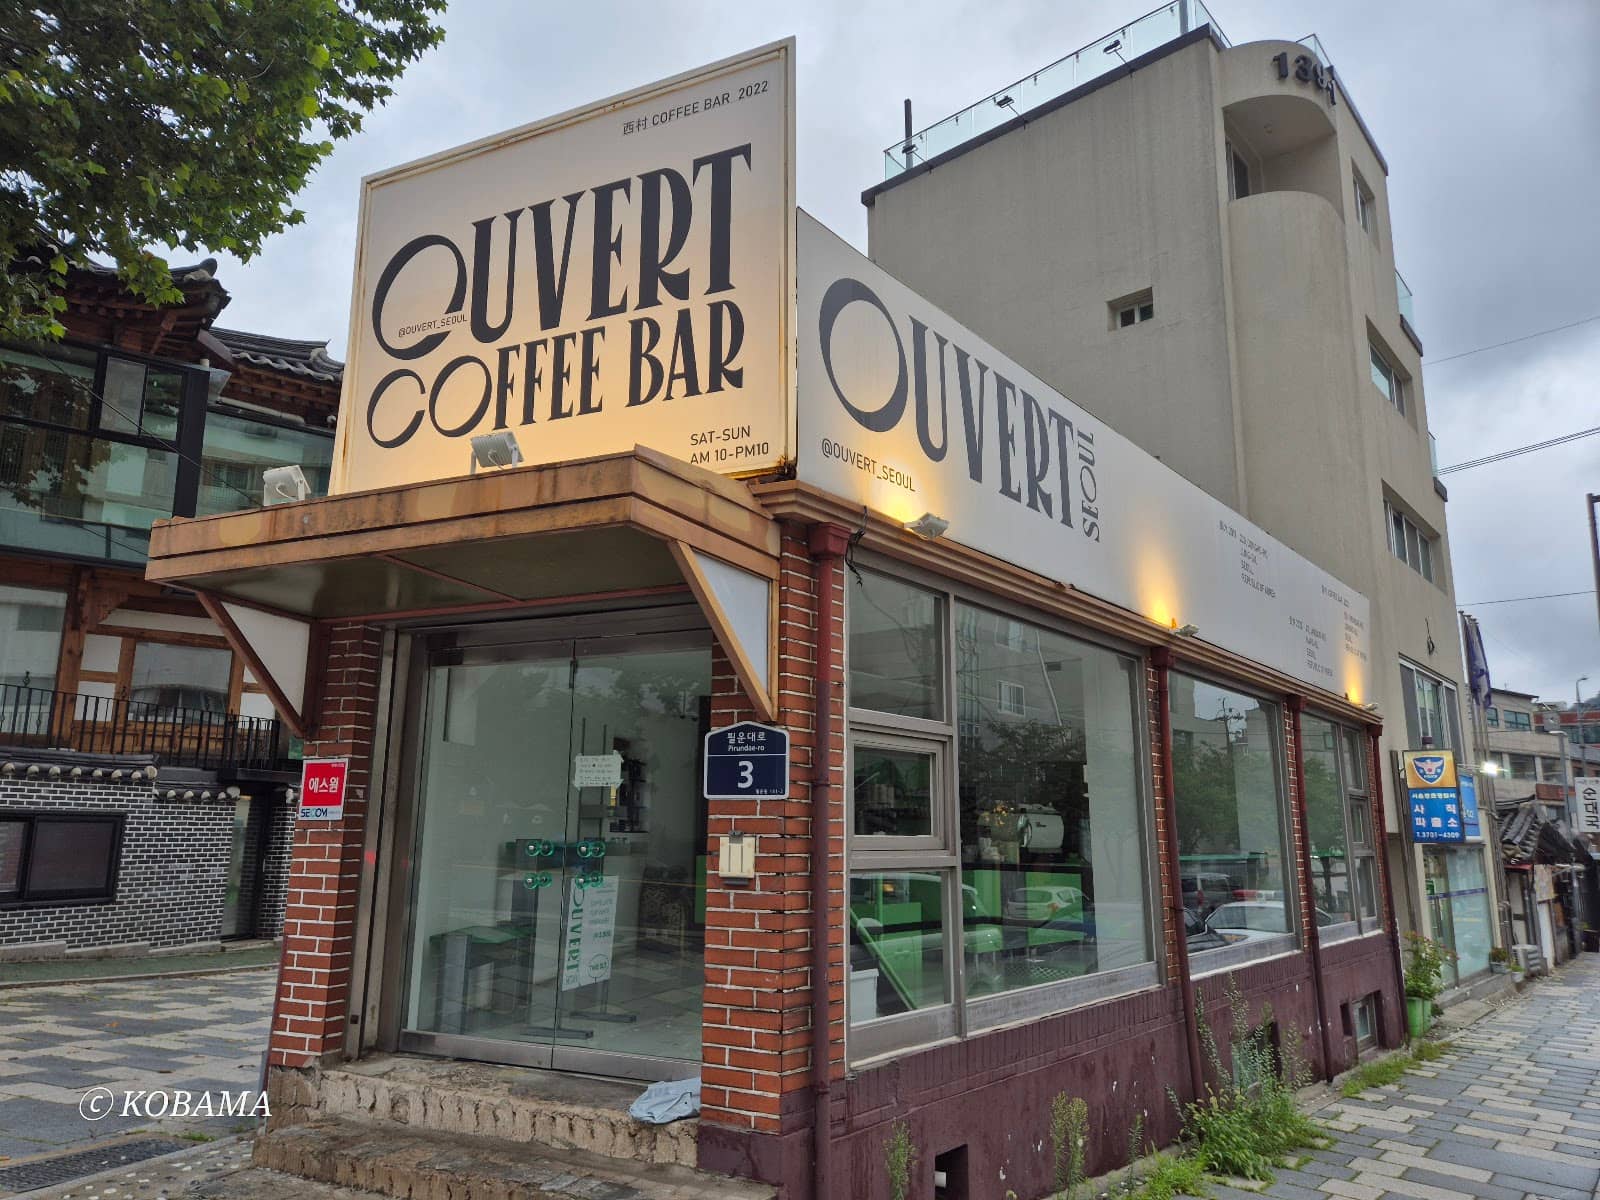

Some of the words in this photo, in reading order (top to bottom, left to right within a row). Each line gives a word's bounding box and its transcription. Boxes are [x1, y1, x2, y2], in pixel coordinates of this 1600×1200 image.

[623, 116, 648, 136] 西村
[652, 101, 700, 126] COFFEE
[738, 80, 769, 100] 2022
[372, 143, 752, 360] OUVERT
[398, 314, 468, 338] @OUVERT_SEOUL
[367, 327, 606, 449] COFFEE
[624, 300, 744, 408] BAR
[819, 277, 1074, 529] OUVERT
[690, 425, 750, 446] SAT-SUN
[690, 451, 710, 465] AM
[822, 438, 916, 492] @OUVERT_SEOUL
[1077, 430, 1100, 543] SEOUL
[728, 731, 767, 744] 필운대로
[308, 776, 339, 793] 에스원
[737, 760, 754, 789] 3
